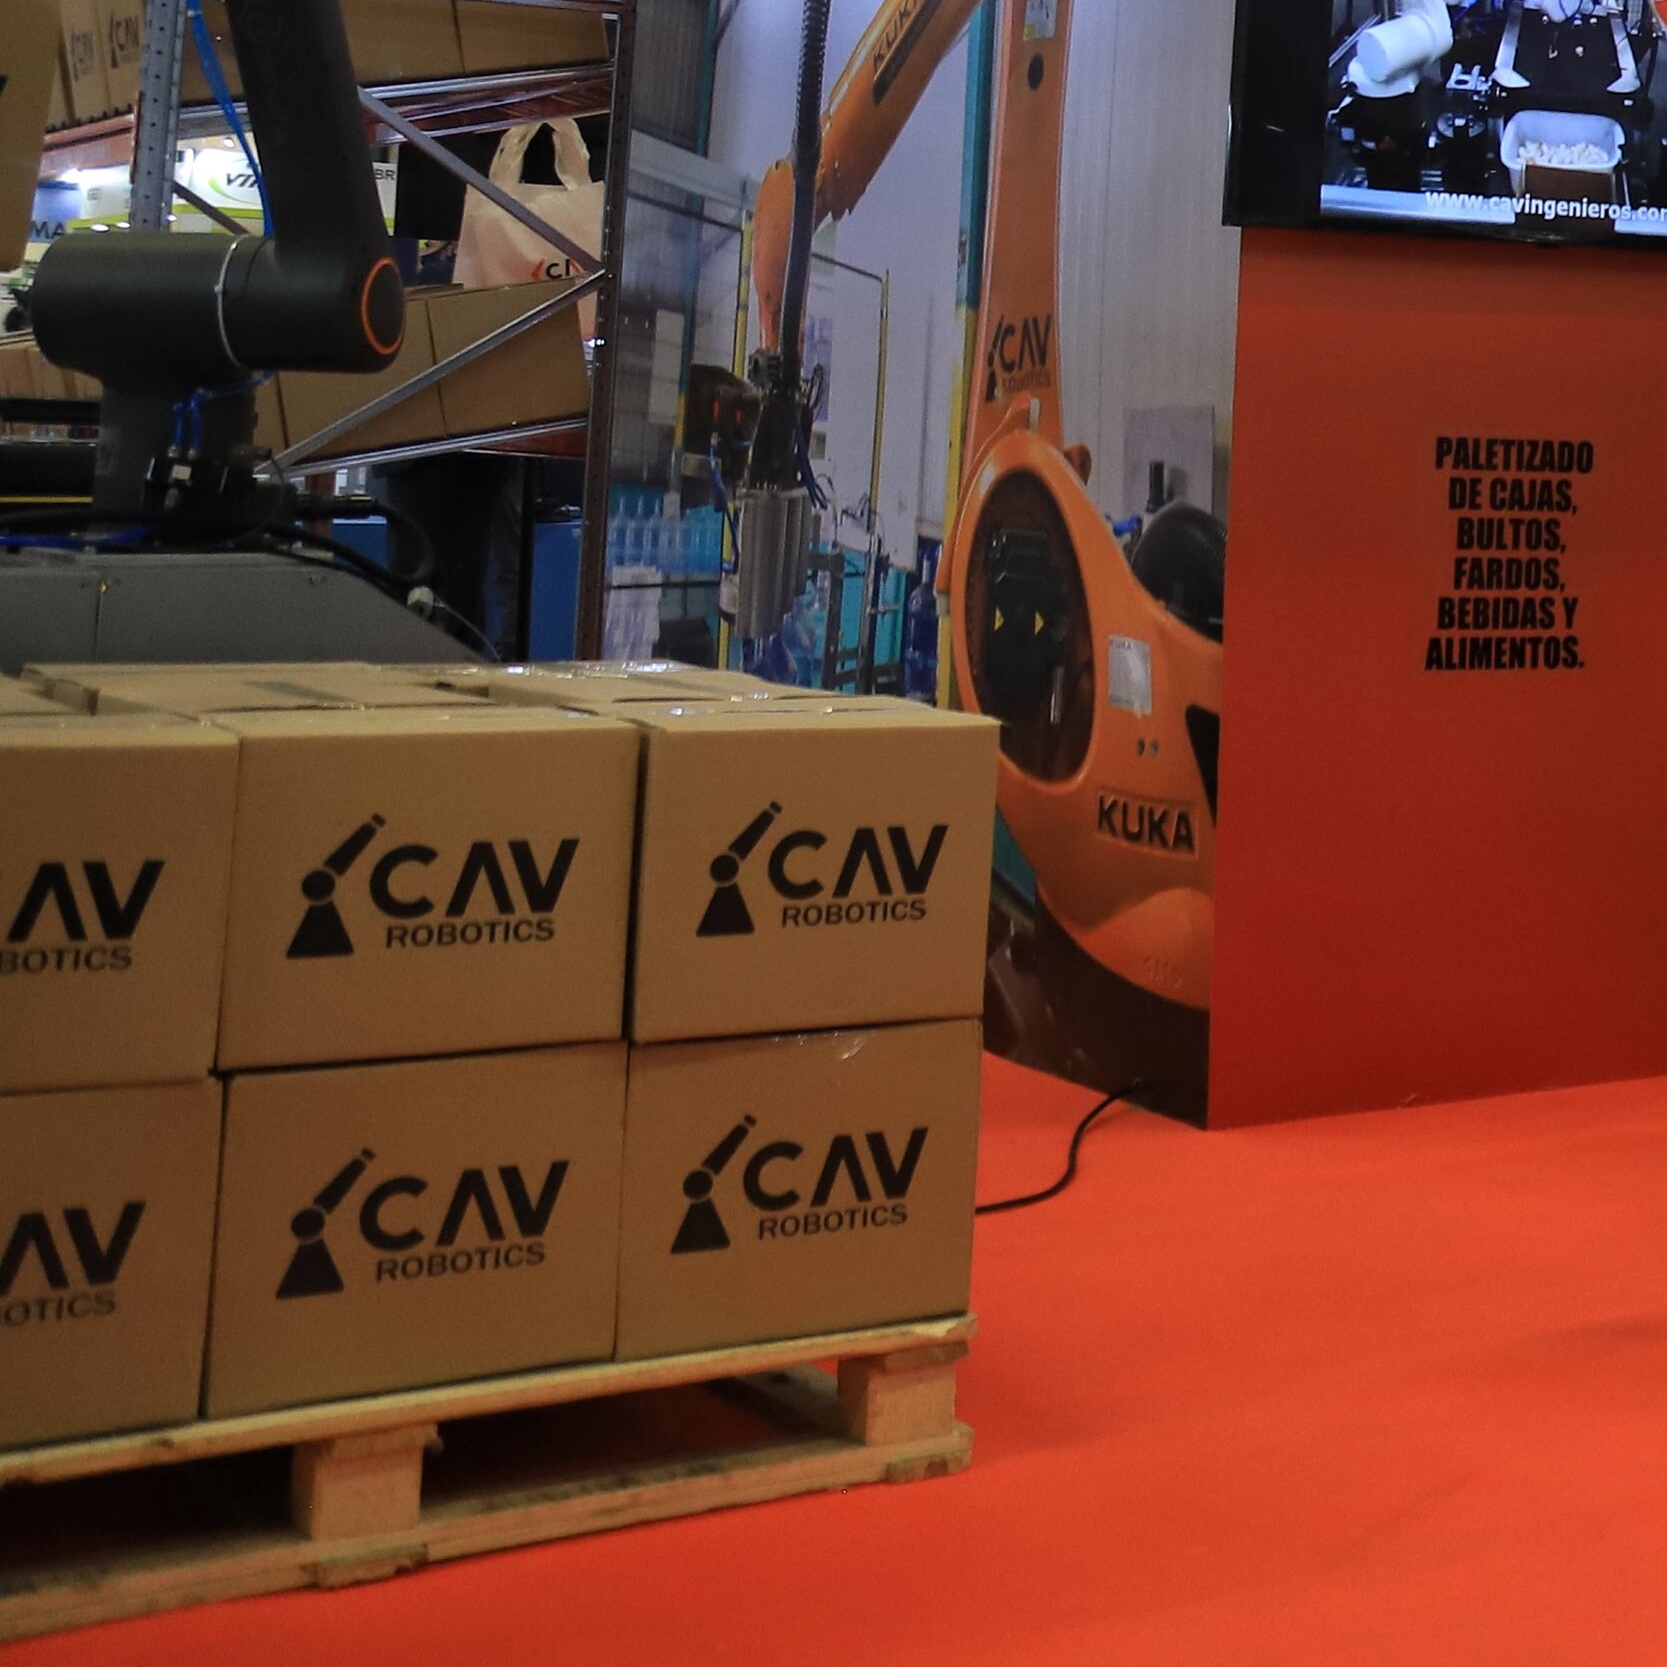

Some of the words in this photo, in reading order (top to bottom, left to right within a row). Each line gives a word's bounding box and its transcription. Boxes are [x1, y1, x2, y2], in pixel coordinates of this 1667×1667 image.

[999, 313, 1052, 373] CAV
[1435, 437, 1594, 474] PALETIZADO
[1448, 477, 1482, 510] DE
[1489, 477, 1578, 515] CAJAS,
[1456, 517, 1566, 553] BULTOS,
[1453, 557, 1565, 592] FARDOS,
[1437, 597, 1556, 630] BEBIDAS
[1562, 597, 1579, 629] Y
[1424, 636, 1585, 671] ALIMENTOS.
[1099, 794, 1195, 852] KUKA
[369, 838, 580, 919] CAV
[766, 824, 948, 900] CAV
[9, 860, 165, 943] AV
[782, 899, 928, 928] ROBOTICS
[386, 917, 556, 949] ROBOTICS
[0, 945, 133, 975] BOTICS
[741, 1127, 929, 1211] CAV
[359, 1160, 570, 1250] CAV
[758, 1204, 908, 1240] ROBOTICS
[0, 1201, 146, 1296] AV
[376, 1241, 546, 1283] ROBOTICS
[3, 1290, 117, 1326] OTICS
